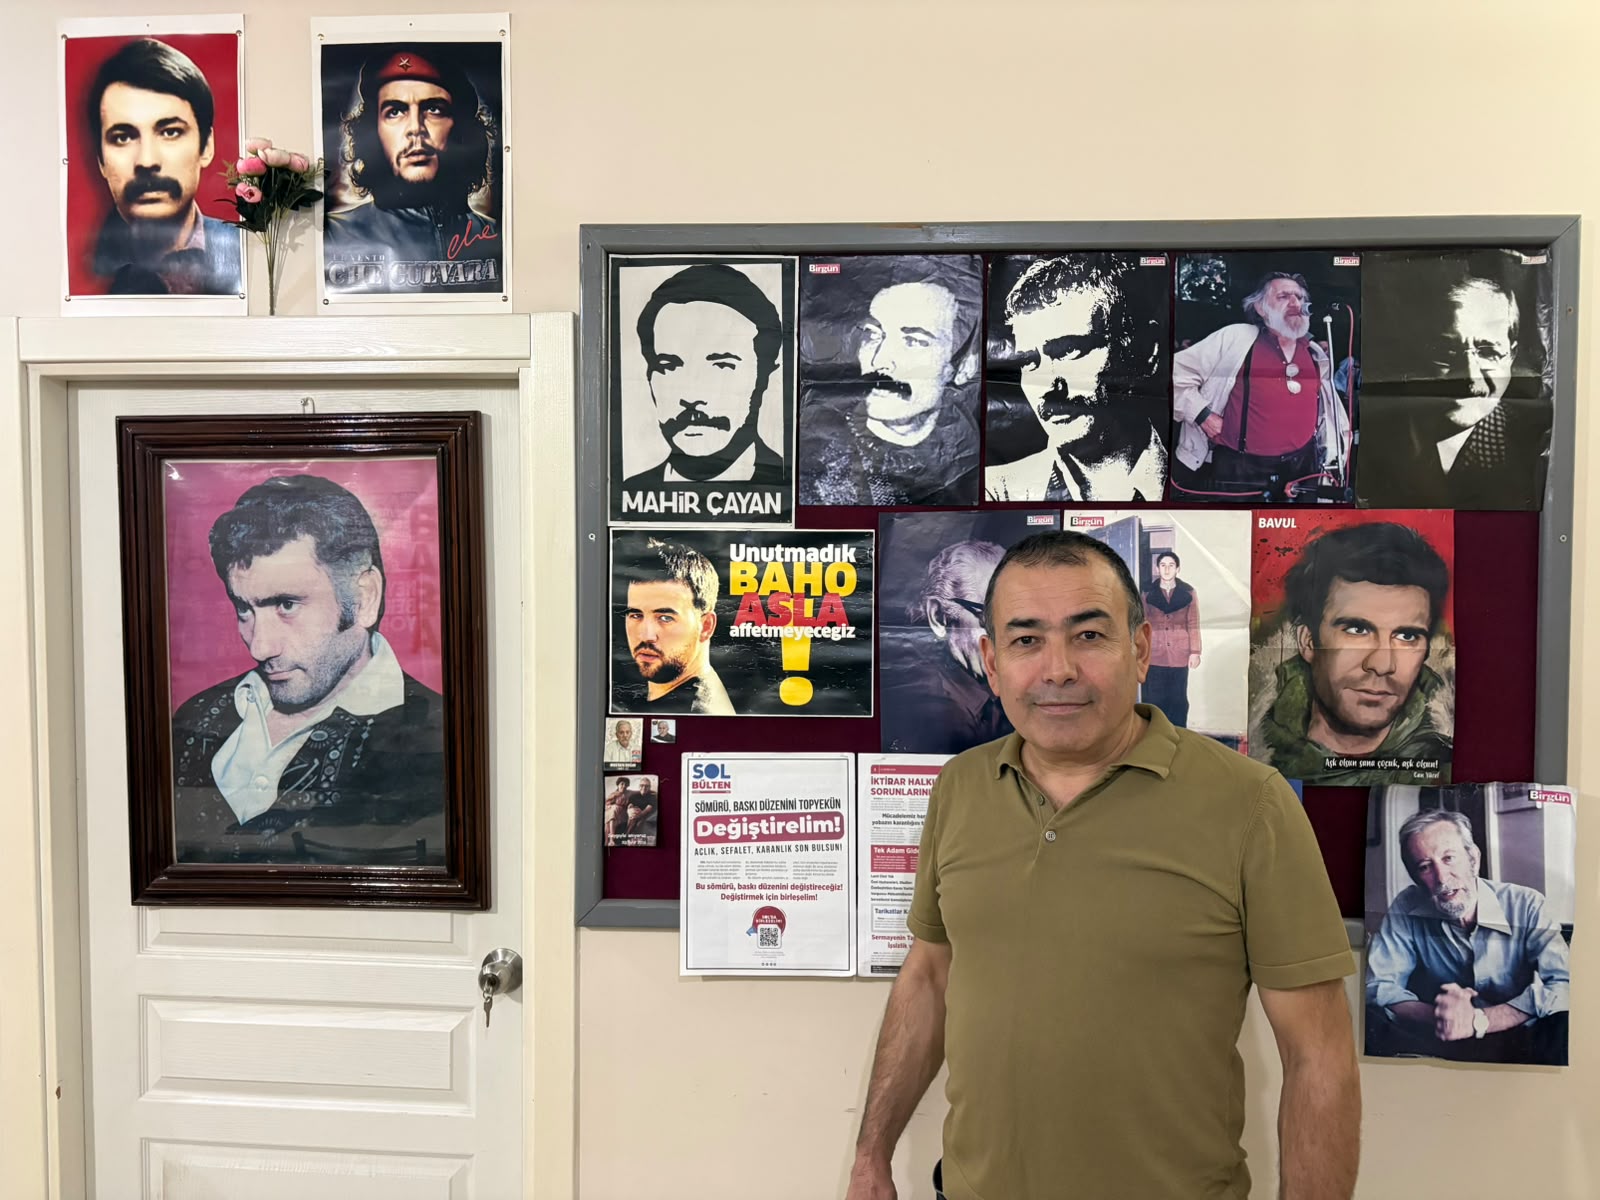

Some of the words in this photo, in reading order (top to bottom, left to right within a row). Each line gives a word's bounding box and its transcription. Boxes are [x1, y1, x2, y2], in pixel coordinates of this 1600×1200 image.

[391, 260, 498, 286] GUEVARA
[706, 492, 782, 515] ÇAYAN
[1258, 517, 1297, 528] BAVUL
[729, 543, 857, 563] Unutmadık
[729, 561, 857, 597] BAHO
[734, 592, 850, 627] ASLA
[729, 622, 856, 641] affetmeyecegiz
[692, 763, 731, 779] SOL
[692, 779, 731, 789] BÜLTEN
[1529, 790, 1570, 803] Birgün
[695, 800, 731, 813] SÖMÜRÜ,
[733, 801, 757, 811] BASKI
[760, 798, 797, 811] DÜZENİNİ
[696, 815, 841, 840] Değiştirelim!
[756, 845, 792, 854] KARANLIK
[795, 844, 809, 852] SON
[811, 843, 843, 851] BULSUN!
[695, 882, 706, 890] Bu
[707, 882, 736, 891] sömürü,
[738, 882, 757, 890] baskı
[758, 882, 789, 890] düzenini
[790, 883, 843, 892] değiştireceğiz!
[720, 893, 764, 901] Değiştirmek
[765, 893, 779, 901] için
[780, 893, 818, 901] birleşelim!
